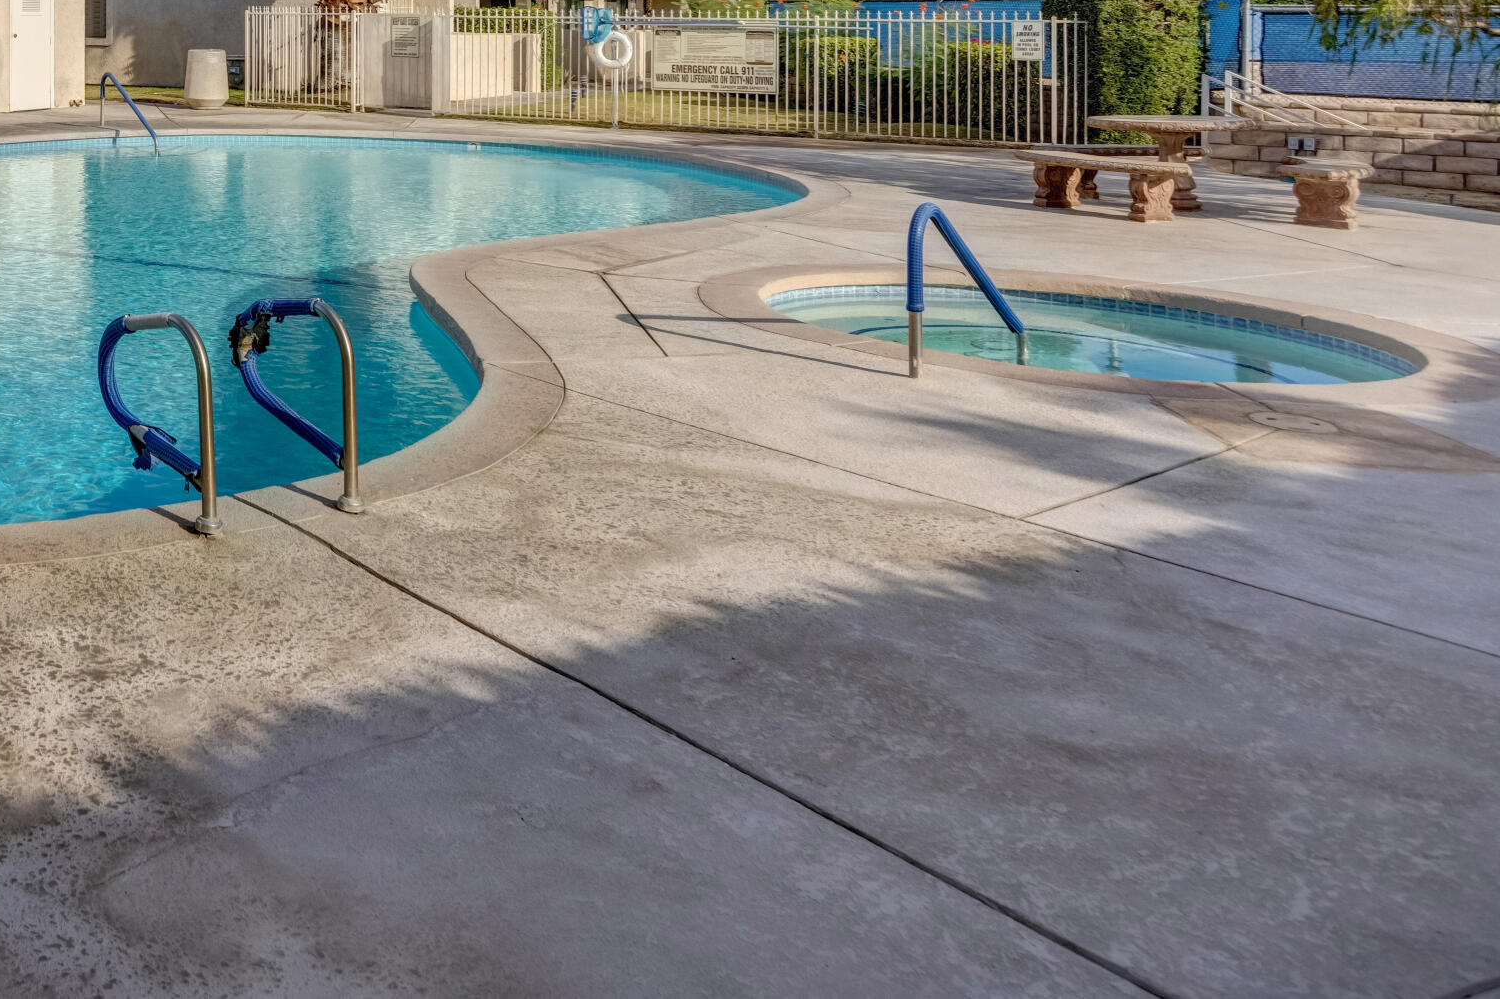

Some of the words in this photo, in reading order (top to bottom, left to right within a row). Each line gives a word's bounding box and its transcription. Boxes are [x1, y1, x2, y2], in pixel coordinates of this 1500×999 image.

[672, 64, 717, 74] EMERGENCY
[720, 66, 739, 74] CALL
[742, 67, 754, 75] 911
[656, 74, 679, 82] WARNING
[682, 74, 689, 82] NO
[691, 75, 718, 83] LIFEGUARD
[720, 75, 728, 84] ON
[755, 77, 774, 86] DIVING
